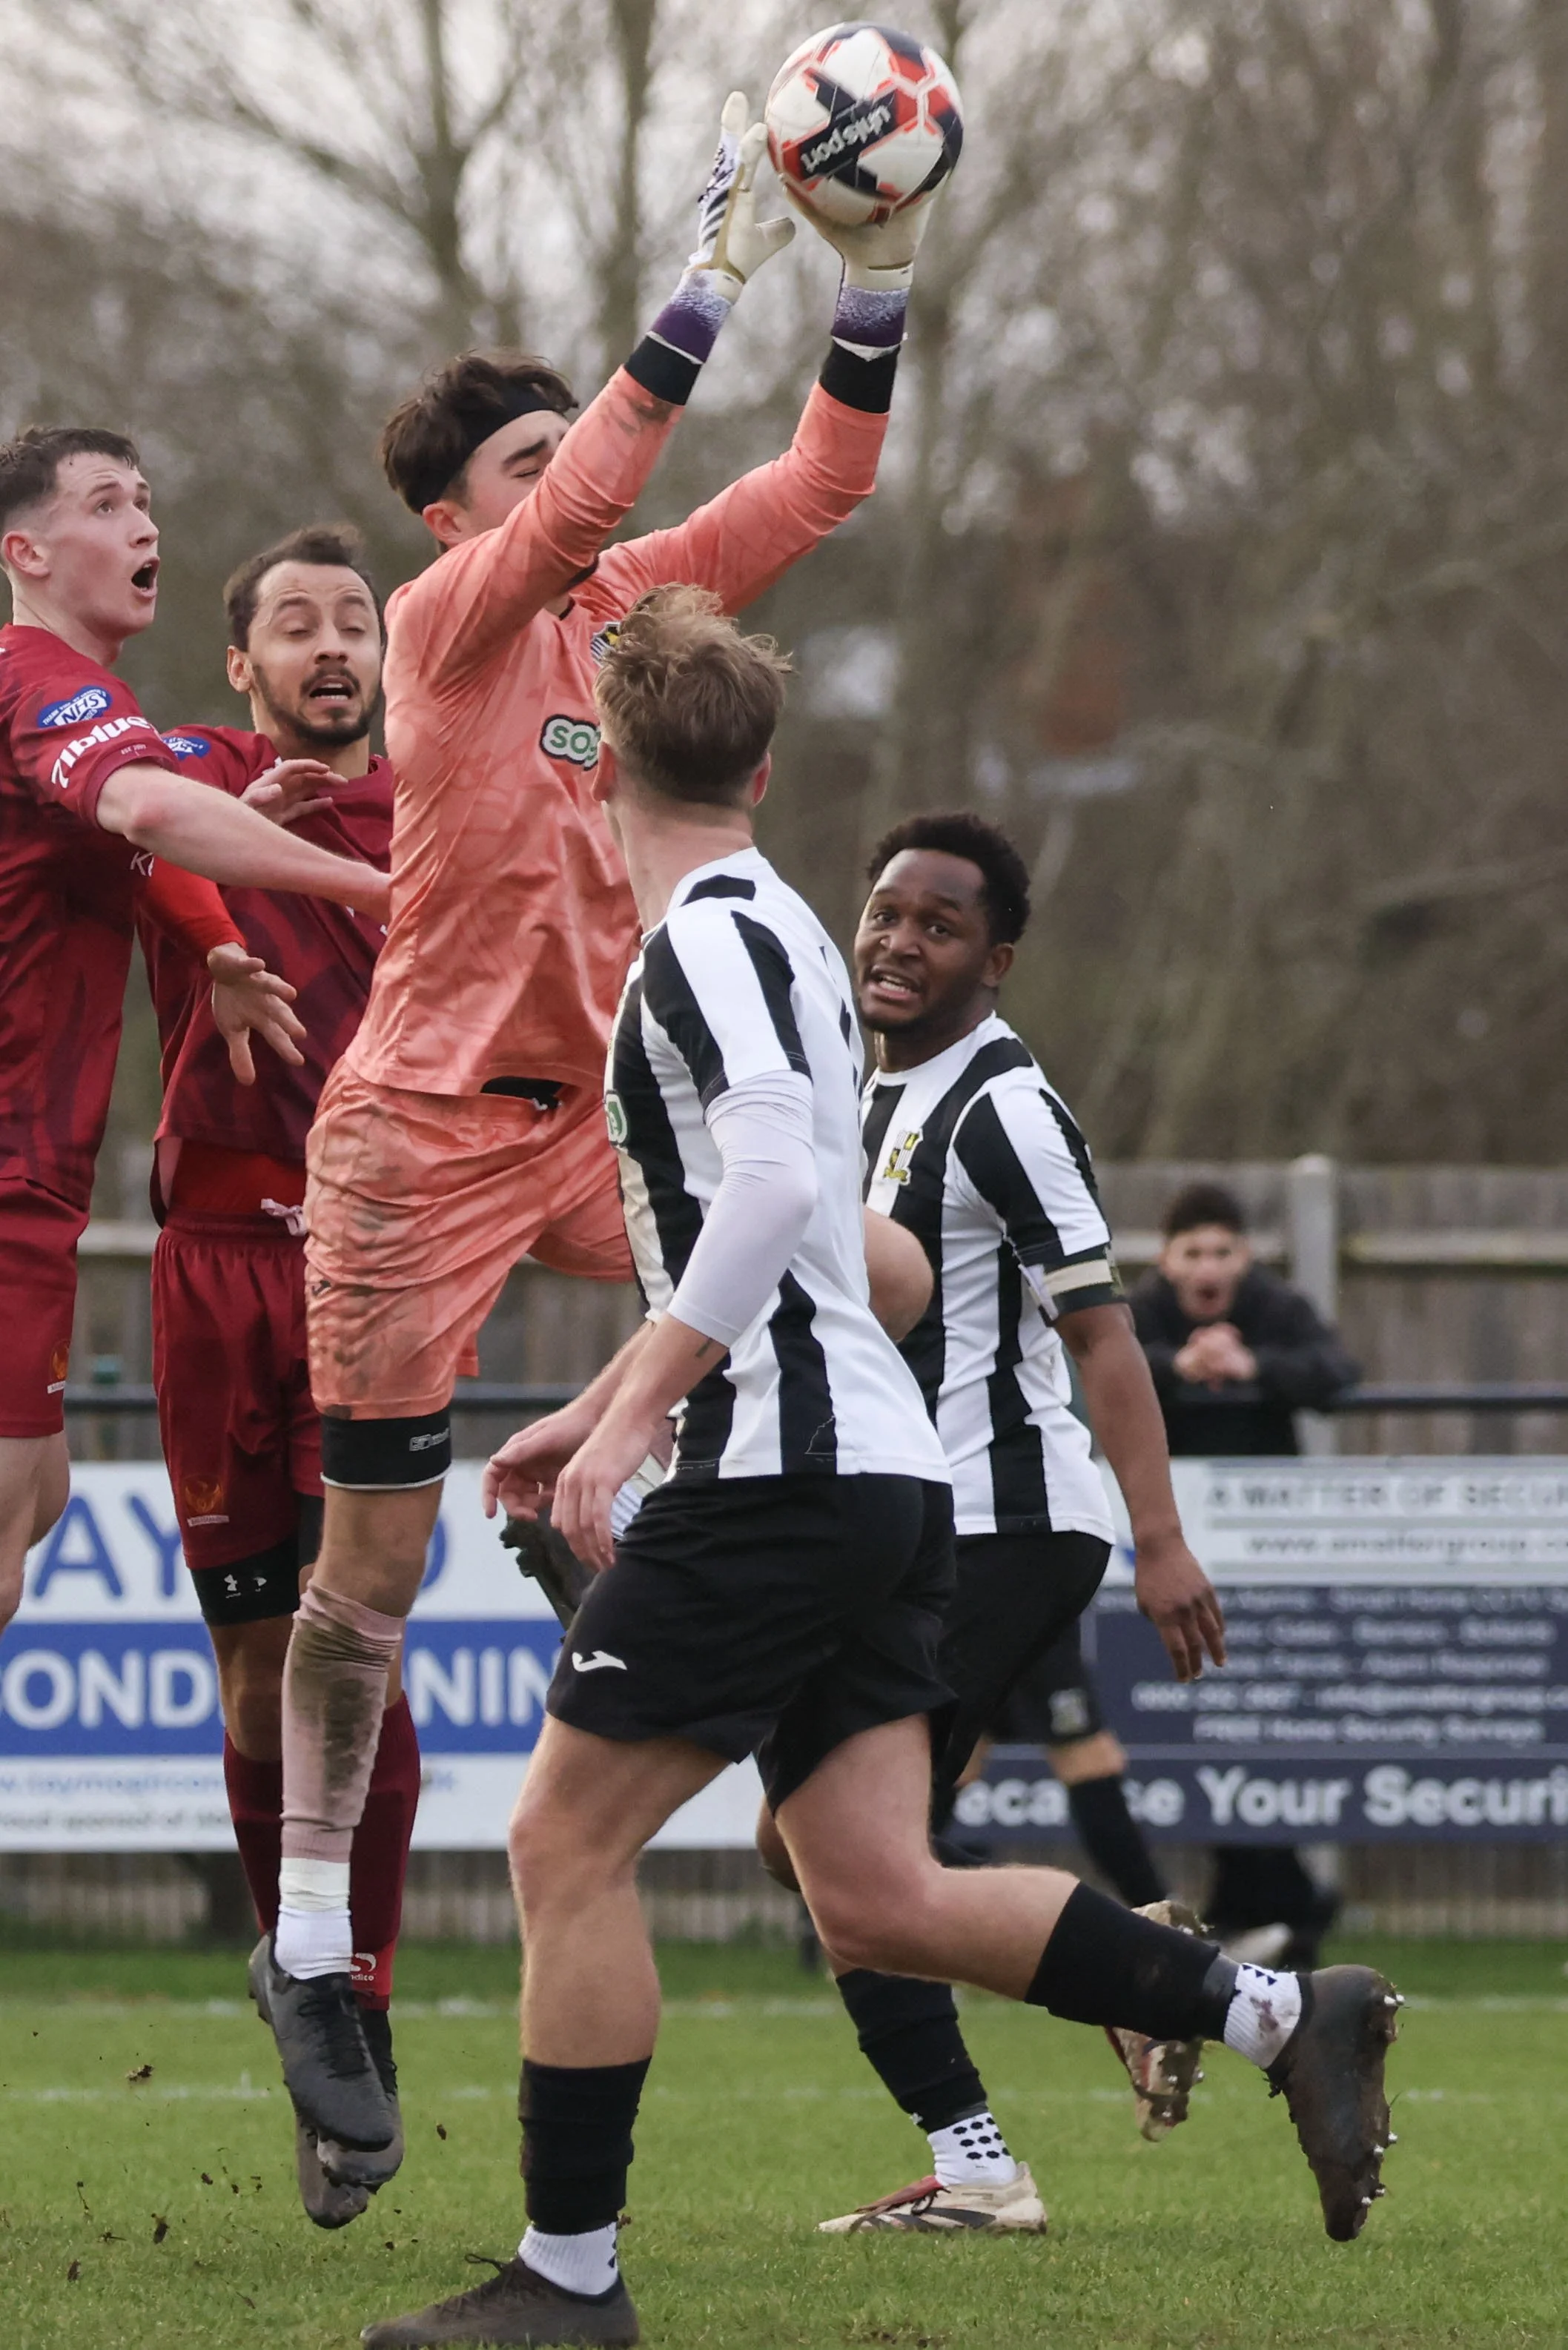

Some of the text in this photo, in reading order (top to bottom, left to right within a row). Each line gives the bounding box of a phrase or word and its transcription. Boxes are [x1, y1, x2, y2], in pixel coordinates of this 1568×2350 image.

[62, 695, 99, 724] NHS
[33, 1492, 184, 1600] AY
[2, 1646, 561, 1730] OND NIN
[1195, 1764, 1351, 1827] Your
[1363, 1764, 1568, 1827] Securi
[351, 1973, 374, 1982] ndico
